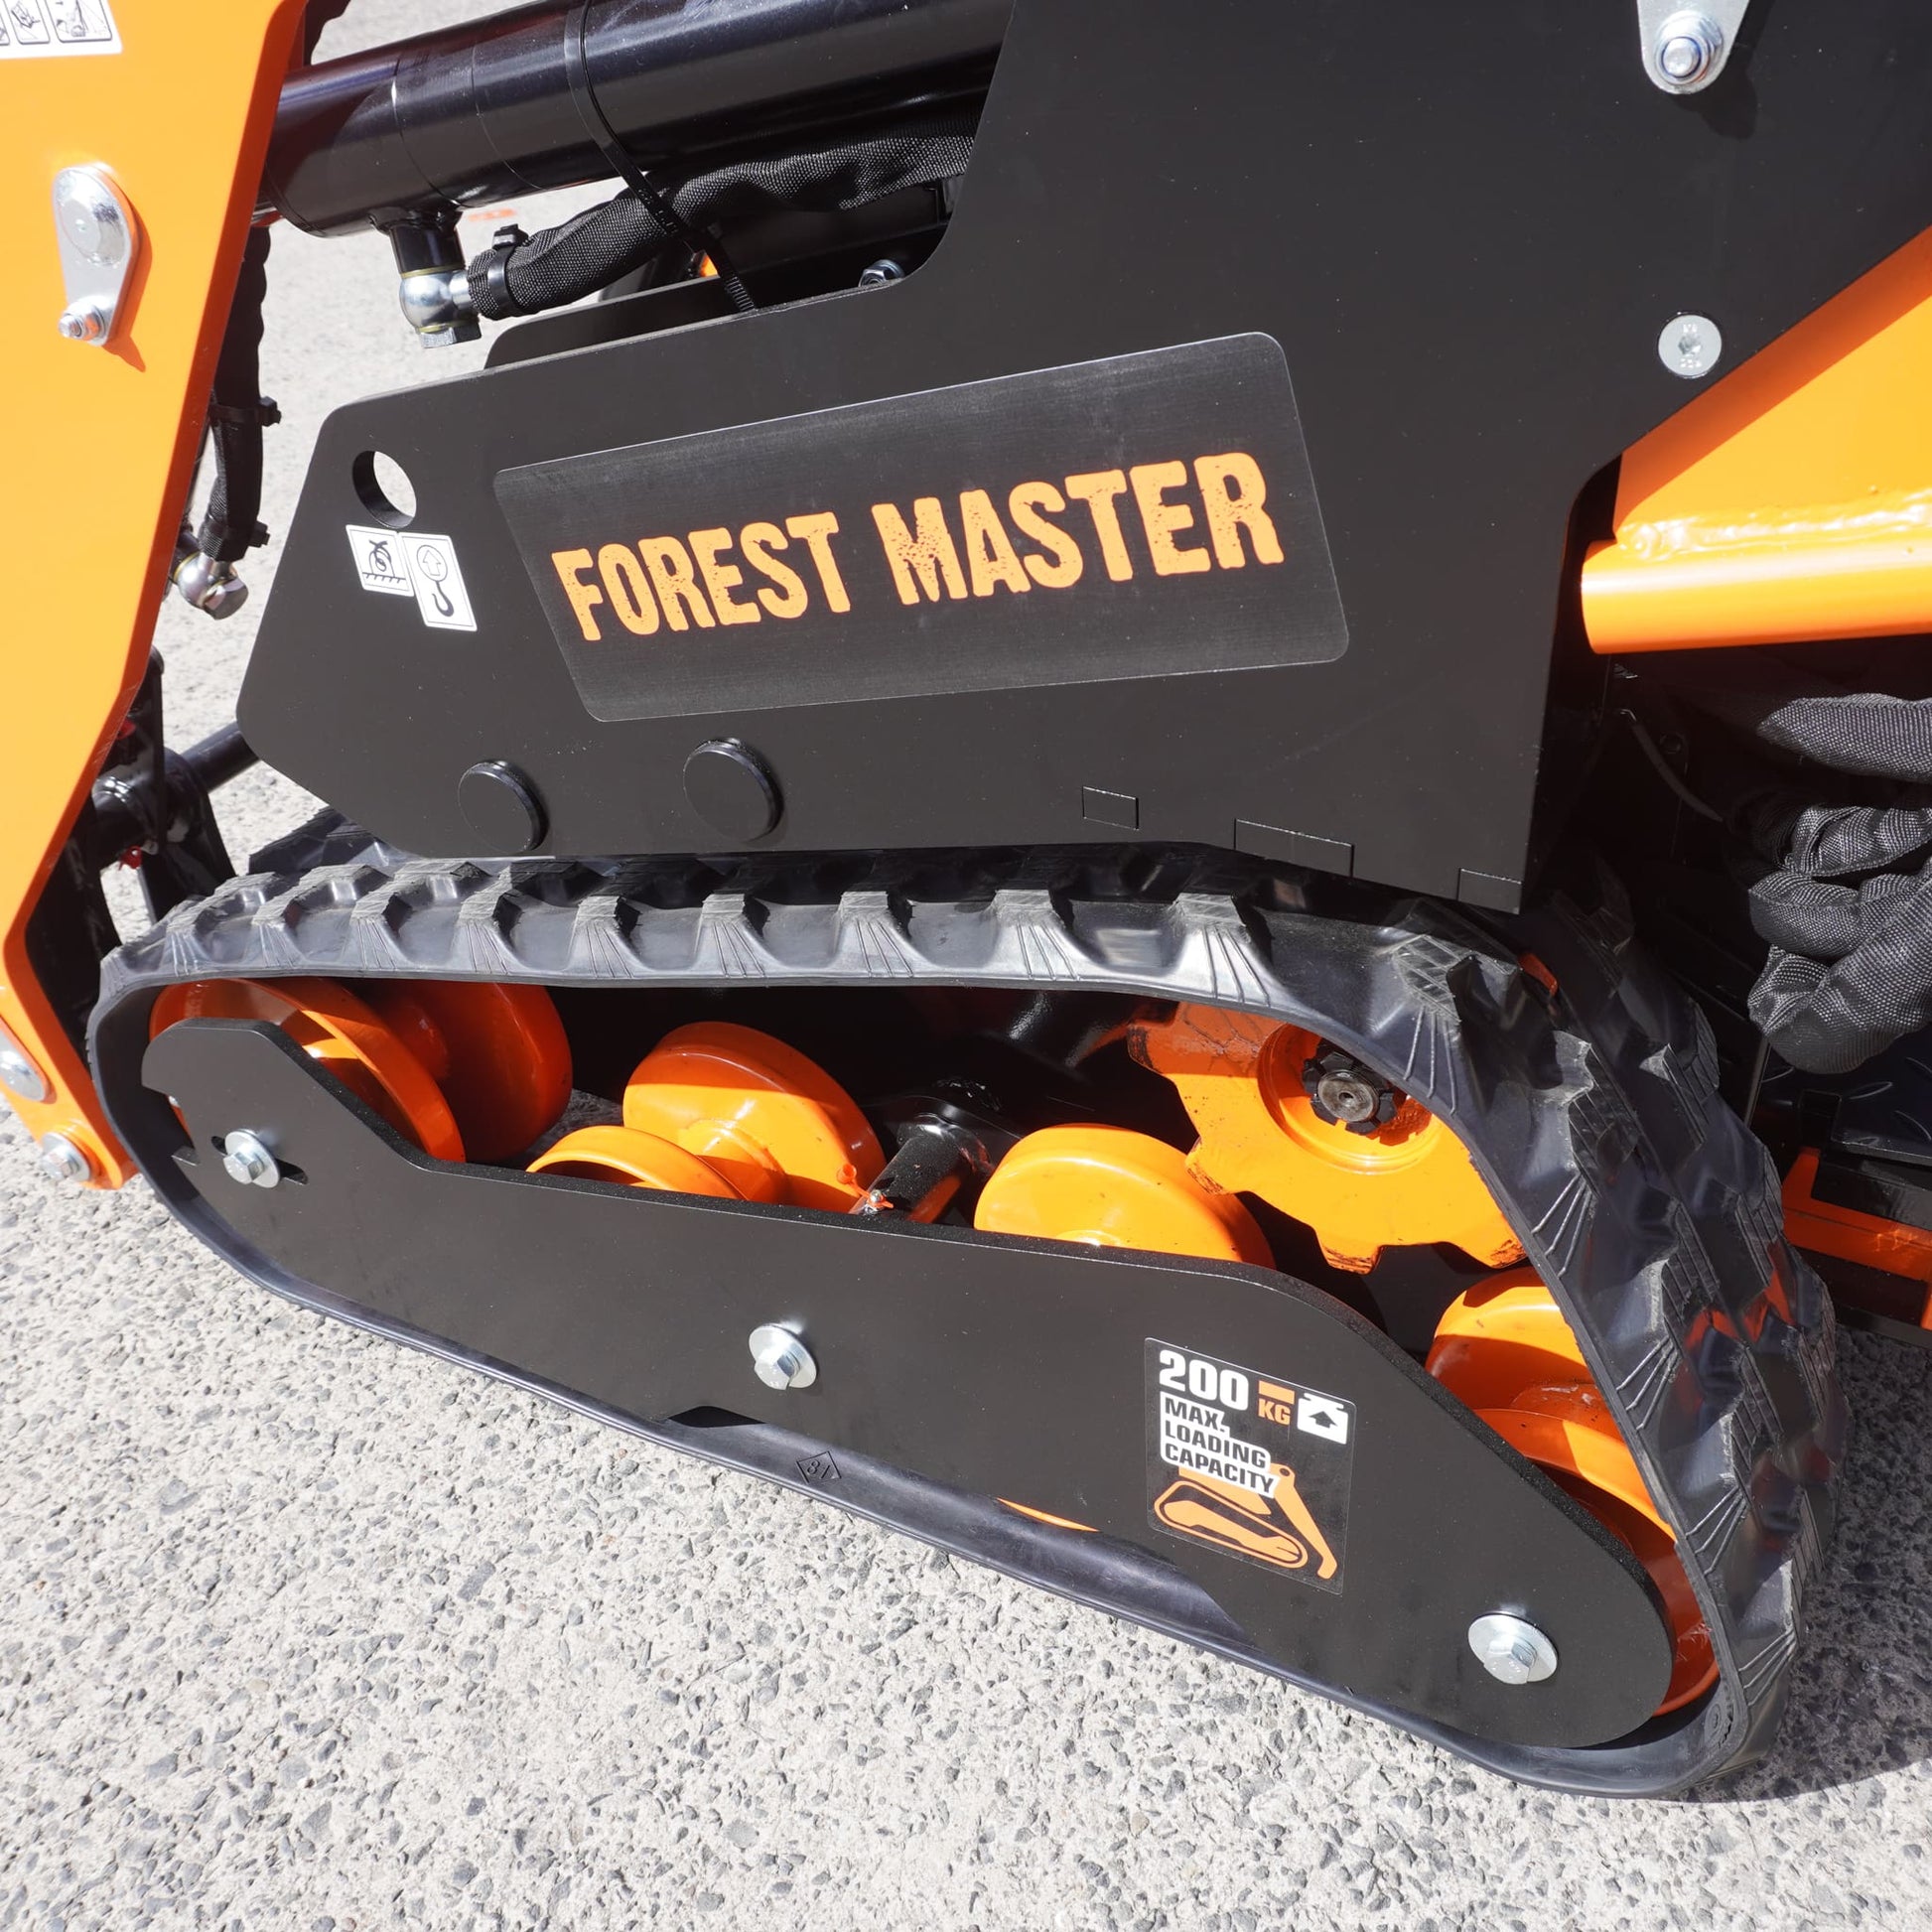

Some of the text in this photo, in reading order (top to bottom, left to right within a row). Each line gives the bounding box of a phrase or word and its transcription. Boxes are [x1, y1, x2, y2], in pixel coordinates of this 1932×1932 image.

[550, 452, 1285, 641] FOREST MASTER
[1159, 1349, 1292, 1427] 200 KG
[1165, 1397, 1227, 1434] MAX.
[1165, 1420, 1268, 1469] LOADING
[1165, 1443, 1275, 1494] CAPACITY
